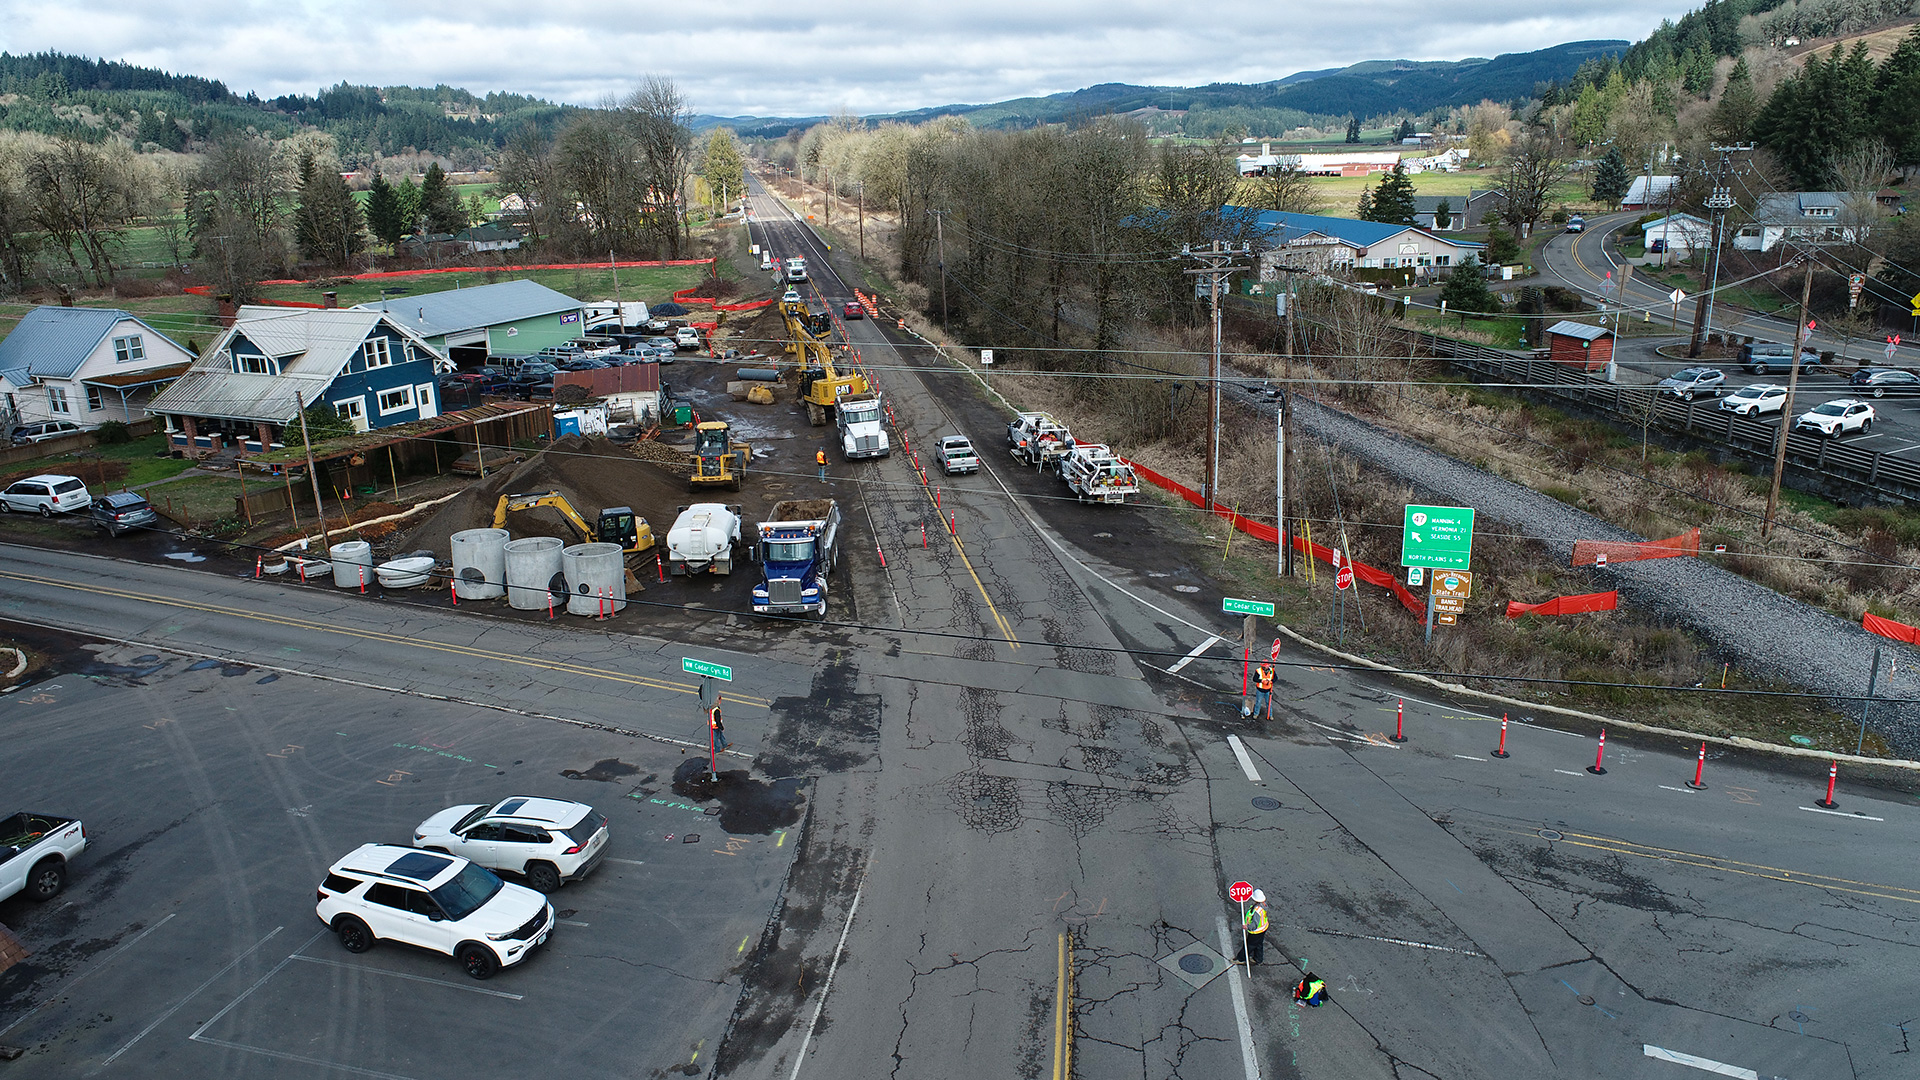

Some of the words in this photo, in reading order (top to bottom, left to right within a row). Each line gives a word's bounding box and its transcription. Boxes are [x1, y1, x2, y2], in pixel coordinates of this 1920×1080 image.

[835, 384, 850, 396] CAT
[1430, 533, 1451, 541] SEASIDE
[1428, 555, 1447, 563] PLAINS
[1336, 573, 1352, 584] STOP
[1436, 588, 1450, 596] State
[1234, 602, 1250, 610] Cedar
[1252, 604, 1264, 612] Cyn
[1435, 604, 1462, 612] TRAILHEAD
[694, 662, 709, 672] Cedar
[711, 666, 721, 675] Cyn
[723, 668, 729, 677] Rd
[1231, 886, 1252, 897] STOP
